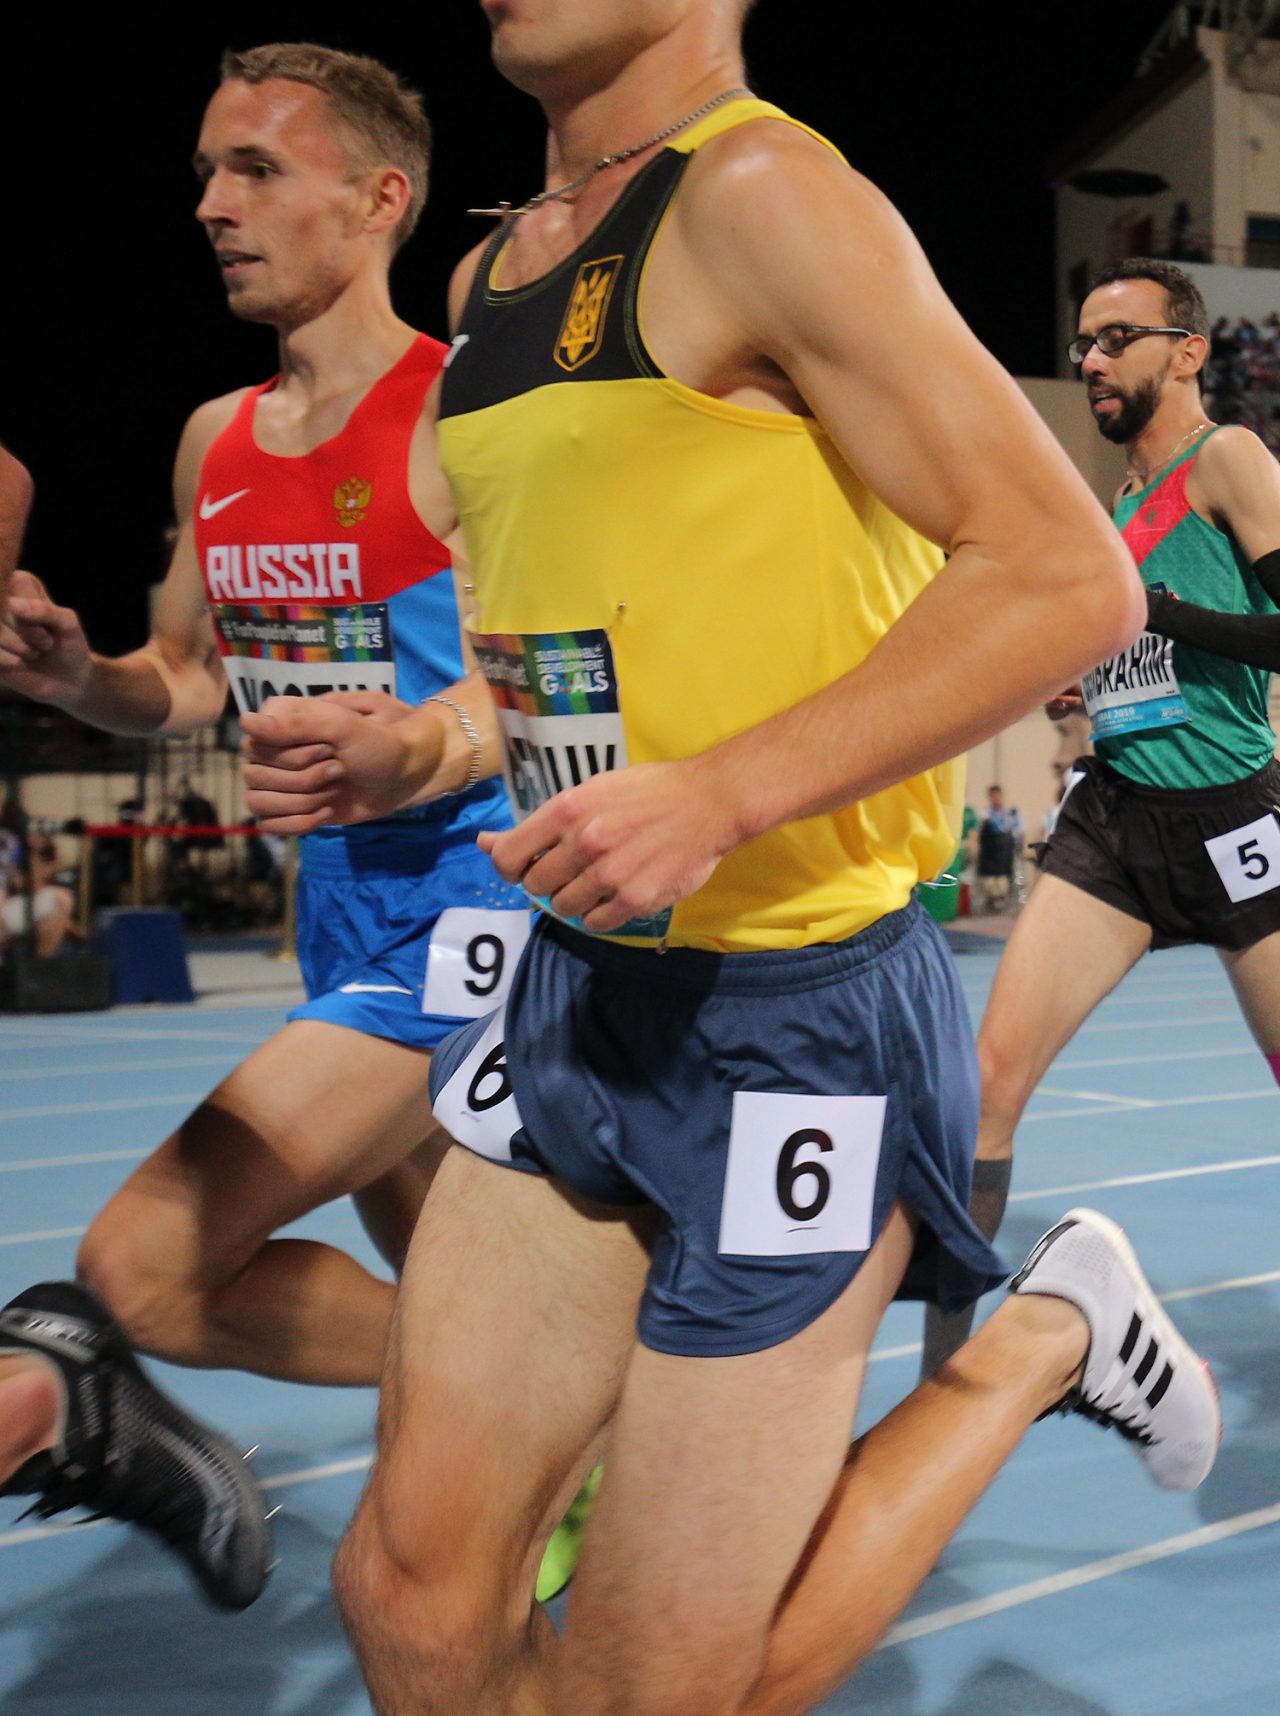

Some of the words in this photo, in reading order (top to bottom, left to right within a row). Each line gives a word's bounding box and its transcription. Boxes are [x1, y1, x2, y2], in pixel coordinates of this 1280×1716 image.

[206, 542, 363, 600] RUSSIA
[334, 633, 384, 650] GALS
[539, 670, 610, 696] GALS
[1237, 839, 1269, 880] 5
[464, 934, 505, 996] 9
[467, 1040, 514, 1112] 6
[776, 1128, 835, 1222] 6
